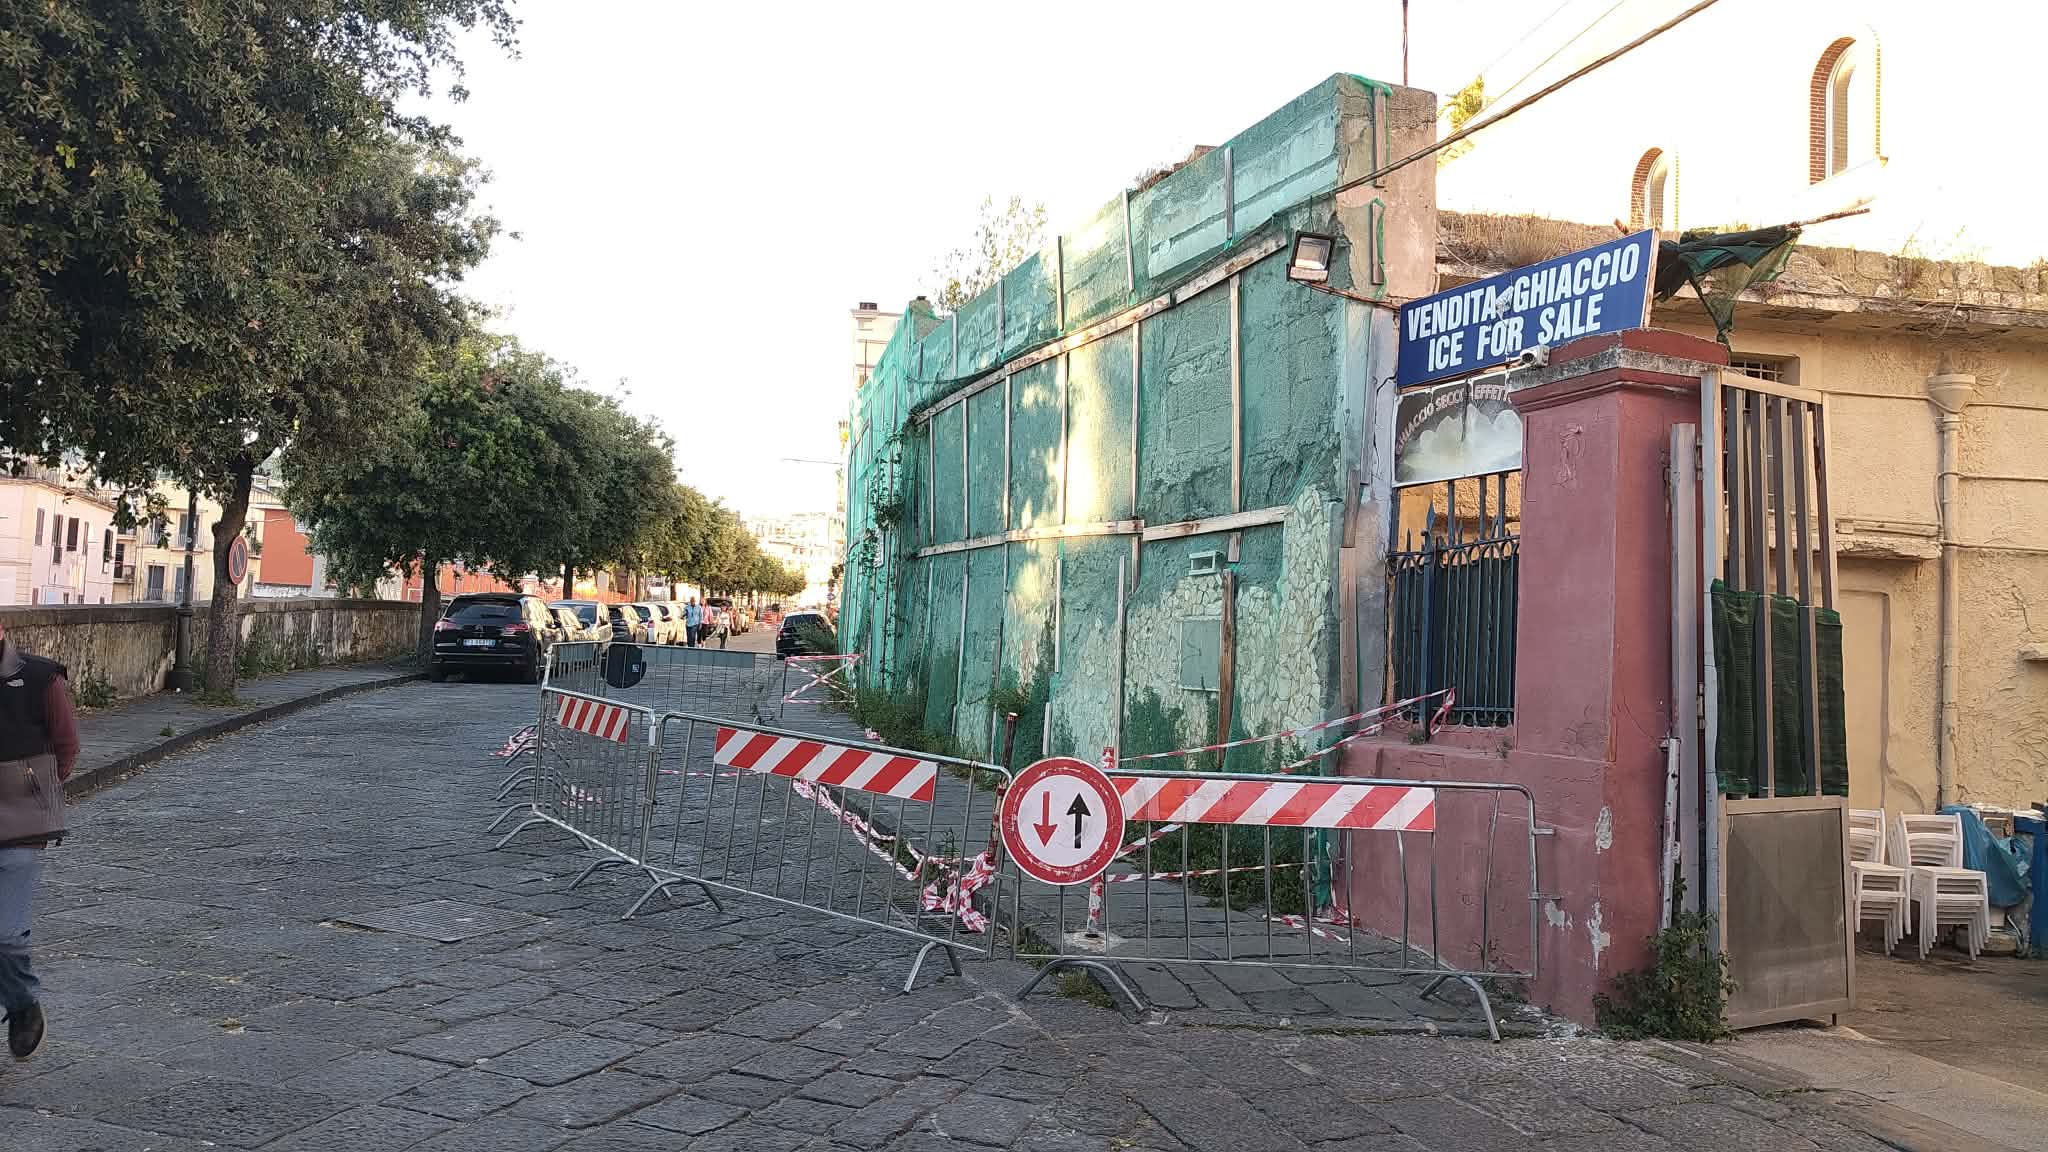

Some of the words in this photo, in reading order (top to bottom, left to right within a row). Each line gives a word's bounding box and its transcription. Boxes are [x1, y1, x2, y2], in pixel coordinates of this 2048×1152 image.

[1408, 285, 1497, 341] VENDITA
[1513, 243, 1640, 317] GHIACCIO
[1428, 335, 1464, 373] ICE
[1477, 316, 1524, 361] FOR
[1537, 294, 1604, 345] SALE
